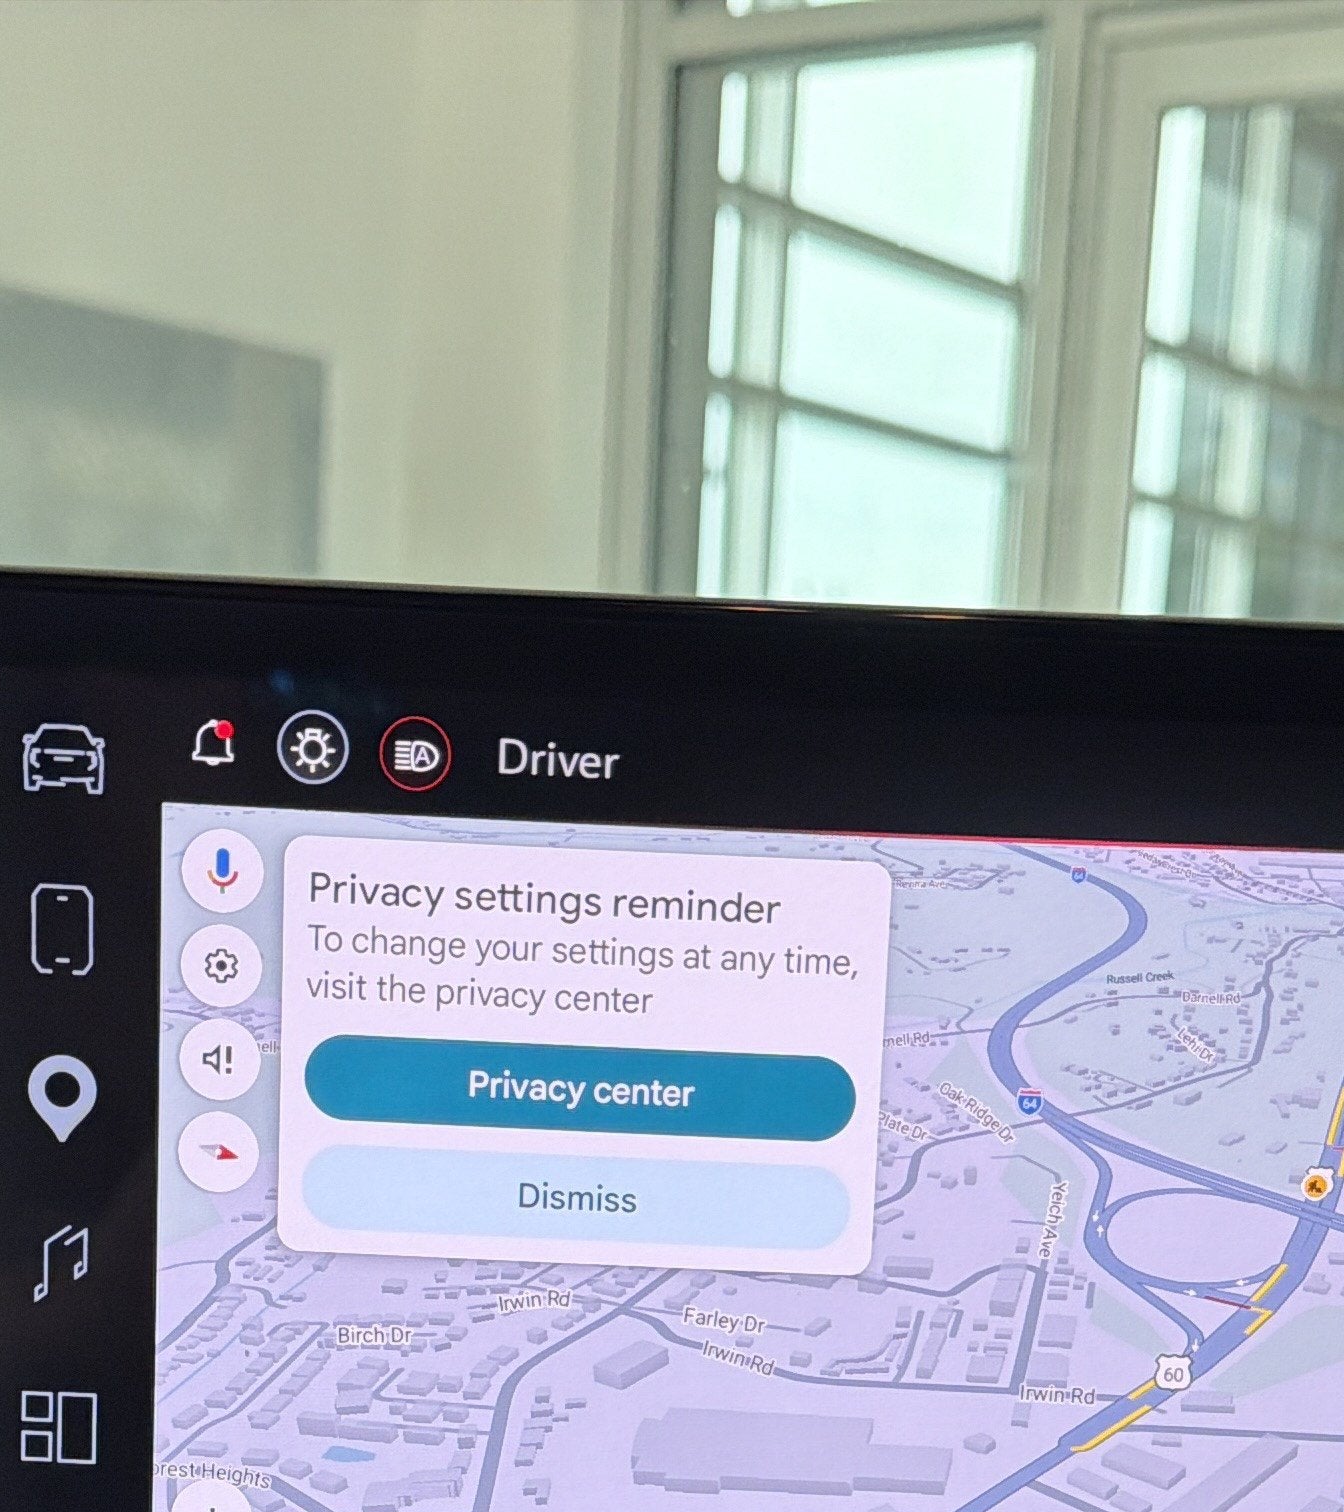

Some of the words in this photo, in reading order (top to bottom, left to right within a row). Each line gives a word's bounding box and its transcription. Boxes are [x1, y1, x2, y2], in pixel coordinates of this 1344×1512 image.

[498, 736, 621, 780] Driver
[310, 871, 445, 918] Privacy
[454, 881, 602, 925] settings
[613, 889, 782, 924] reminder
[307, 923, 343, 952] To
[351, 925, 466, 965] change
[474, 938, 544, 967] your
[552, 936, 674, 975] settings
[682, 944, 712, 970] at
[720, 950, 776, 980] any
[784, 945, 858, 981] time,
[1106, 974, 1143, 985] Russell
[1145, 970, 1176, 983] Creek
[306, 970, 368, 1001] visit
[376, 973, 426, 1004] the
[436, 976, 547, 1017] privacy
[554, 987, 654, 1014] center
[913, 1031, 930, 1044] Rd
[467, 1070, 587, 1109] Privacy
[593, 1078, 696, 1108] center
[939, 1081, 964, 1104] Oak
[965, 1096, 1001, 1133] Ridge
[997, 1125, 1015, 1144] Dr
[1022, 1098, 1038, 1110] 64
[911, 1125, 928, 1141] Dr
[517, 1181, 638, 1215] Dismiss
[1038, 1227, 1058, 1258] Ave
[498, 1292, 542, 1312] Irwin
[547, 1289, 571, 1308] Rd
[683, 1306, 740, 1333] Farley
[744, 1315, 766, 1333] Dr
[338, 1326, 385, 1344] Birch
[390, 1327, 413, 1343] Dr
[702, 1340, 746, 1367] Irwin
[750, 1354, 775, 1376] Rd
[1162, 1366, 1185, 1383] 60
[1020, 1384, 1064, 1403] Irwin
[1071, 1387, 1096, 1405] Rd
[202, 1462, 272, 1489] Heights
